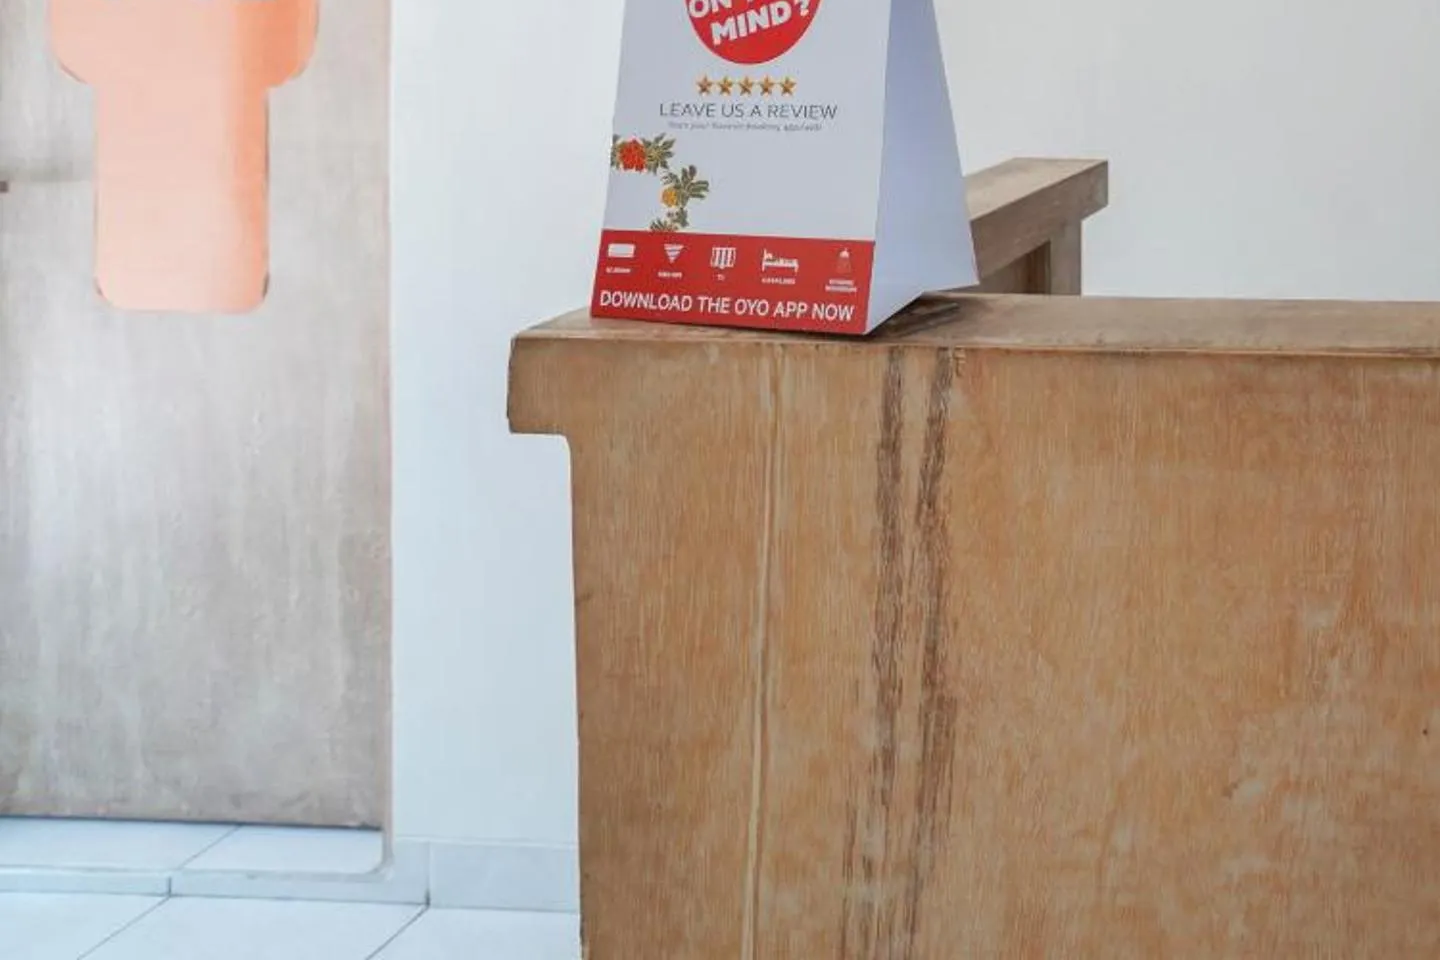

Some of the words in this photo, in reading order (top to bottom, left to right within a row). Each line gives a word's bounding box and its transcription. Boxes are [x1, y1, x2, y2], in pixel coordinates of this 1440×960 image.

[659, 103, 716, 118] LEAVE
[721, 103, 744, 118] US
[750, 104, 762, 118] A
[767, 104, 838, 120] REVIEW
[600, 290, 692, 312] DOWNLOAD
[697, 296, 731, 314] THE
[734, 298, 769, 316] OYO
[773, 301, 808, 319] APP
[812, 302, 855, 321] NOW
